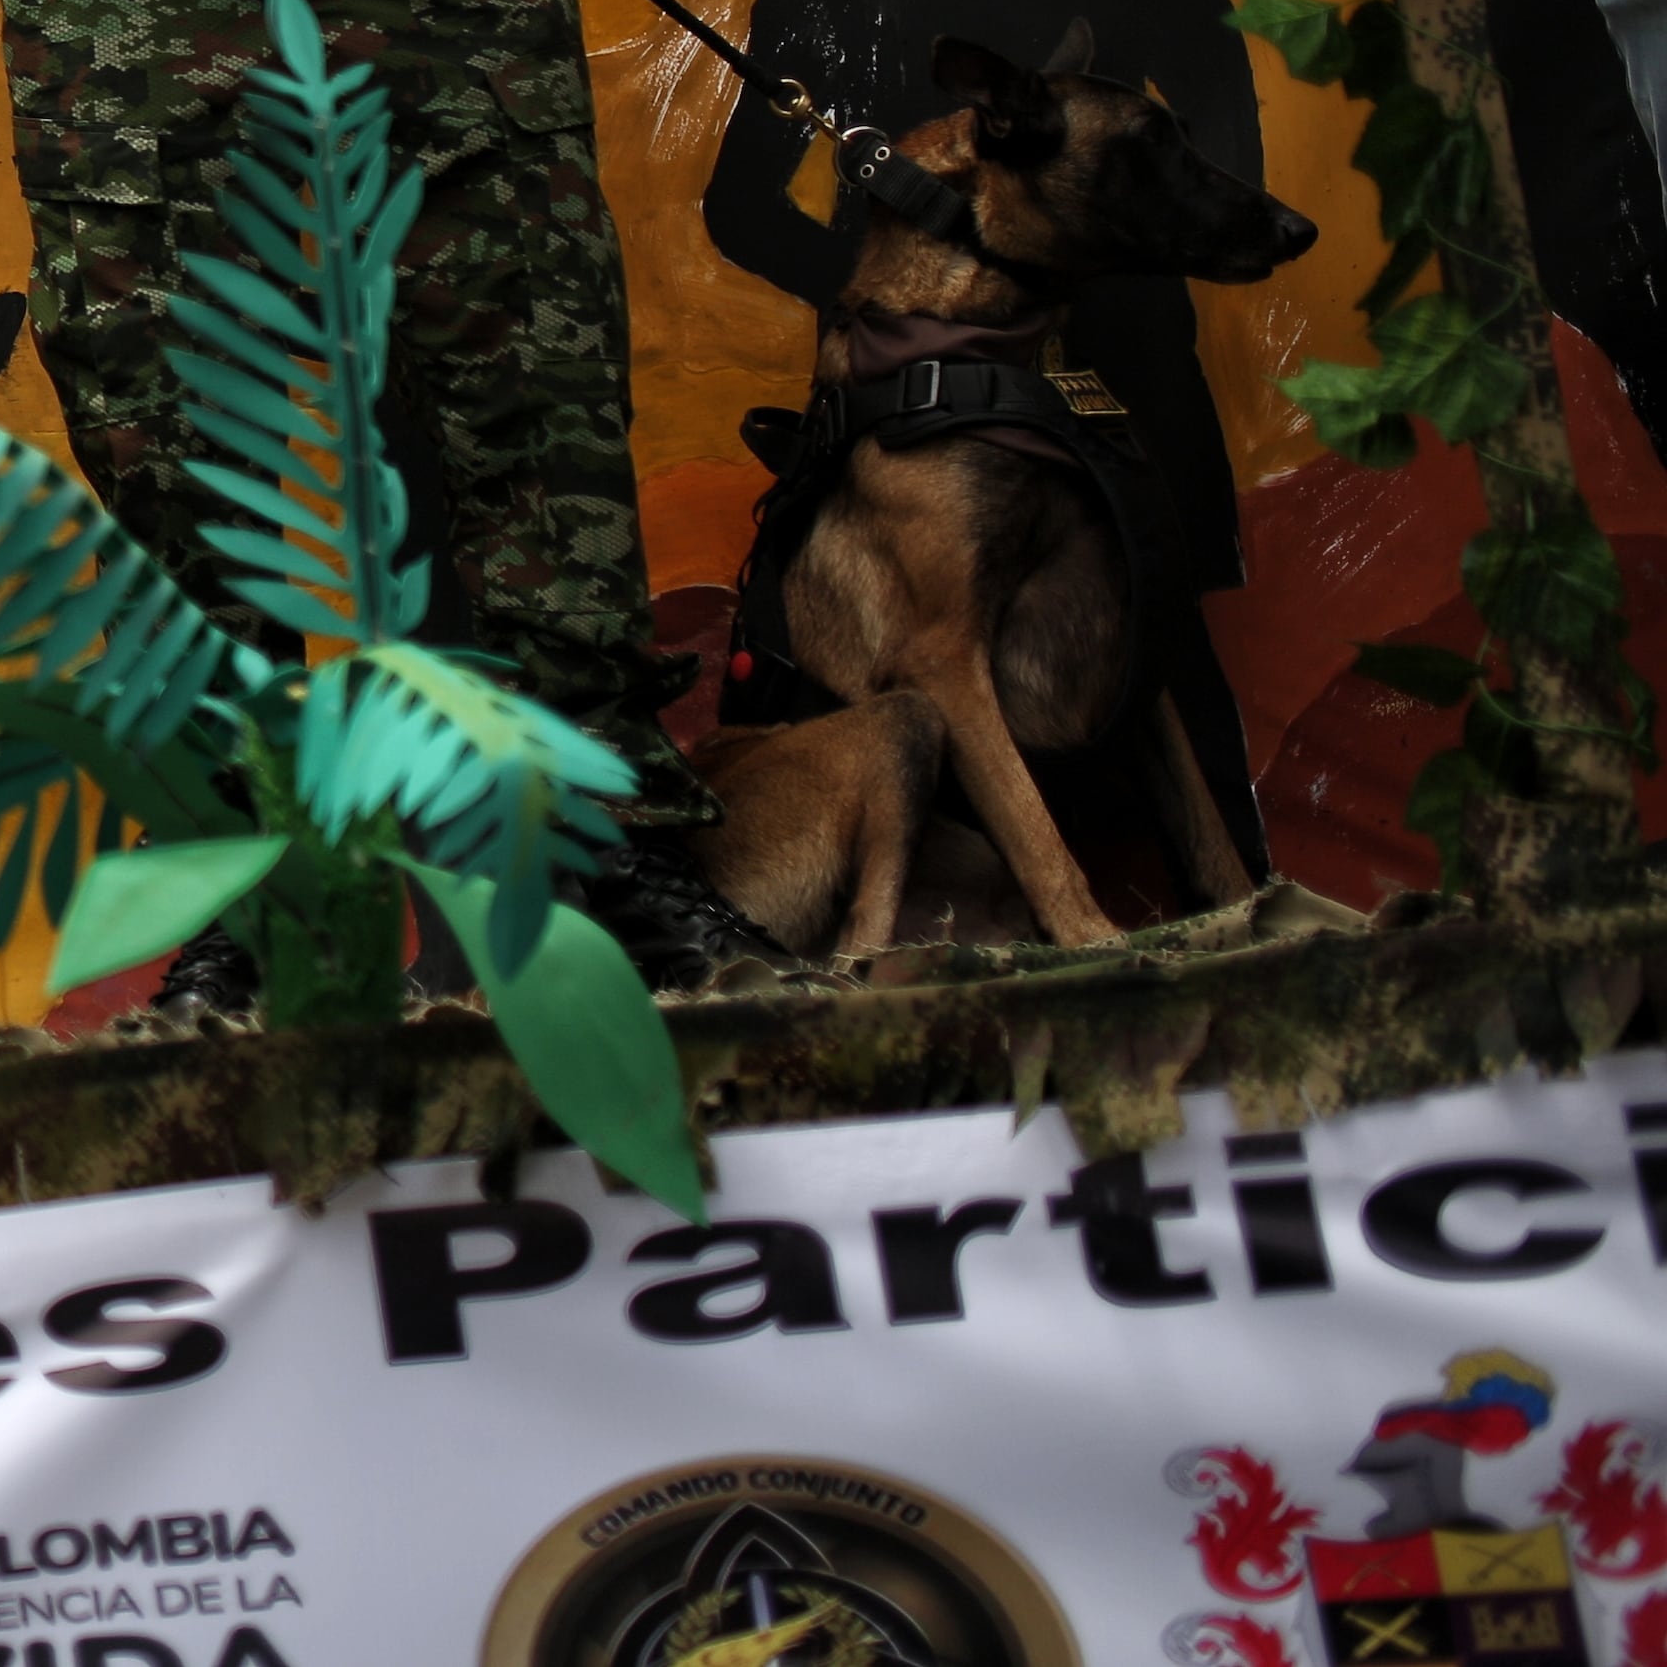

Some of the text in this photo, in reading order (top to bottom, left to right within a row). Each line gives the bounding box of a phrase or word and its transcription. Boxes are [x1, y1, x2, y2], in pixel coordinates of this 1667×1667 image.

[581, 1469, 926, 1550] COMANDO CONJUNTO
[155, 1576, 224, 1618] DE
[237, 1574, 304, 1613] LA
